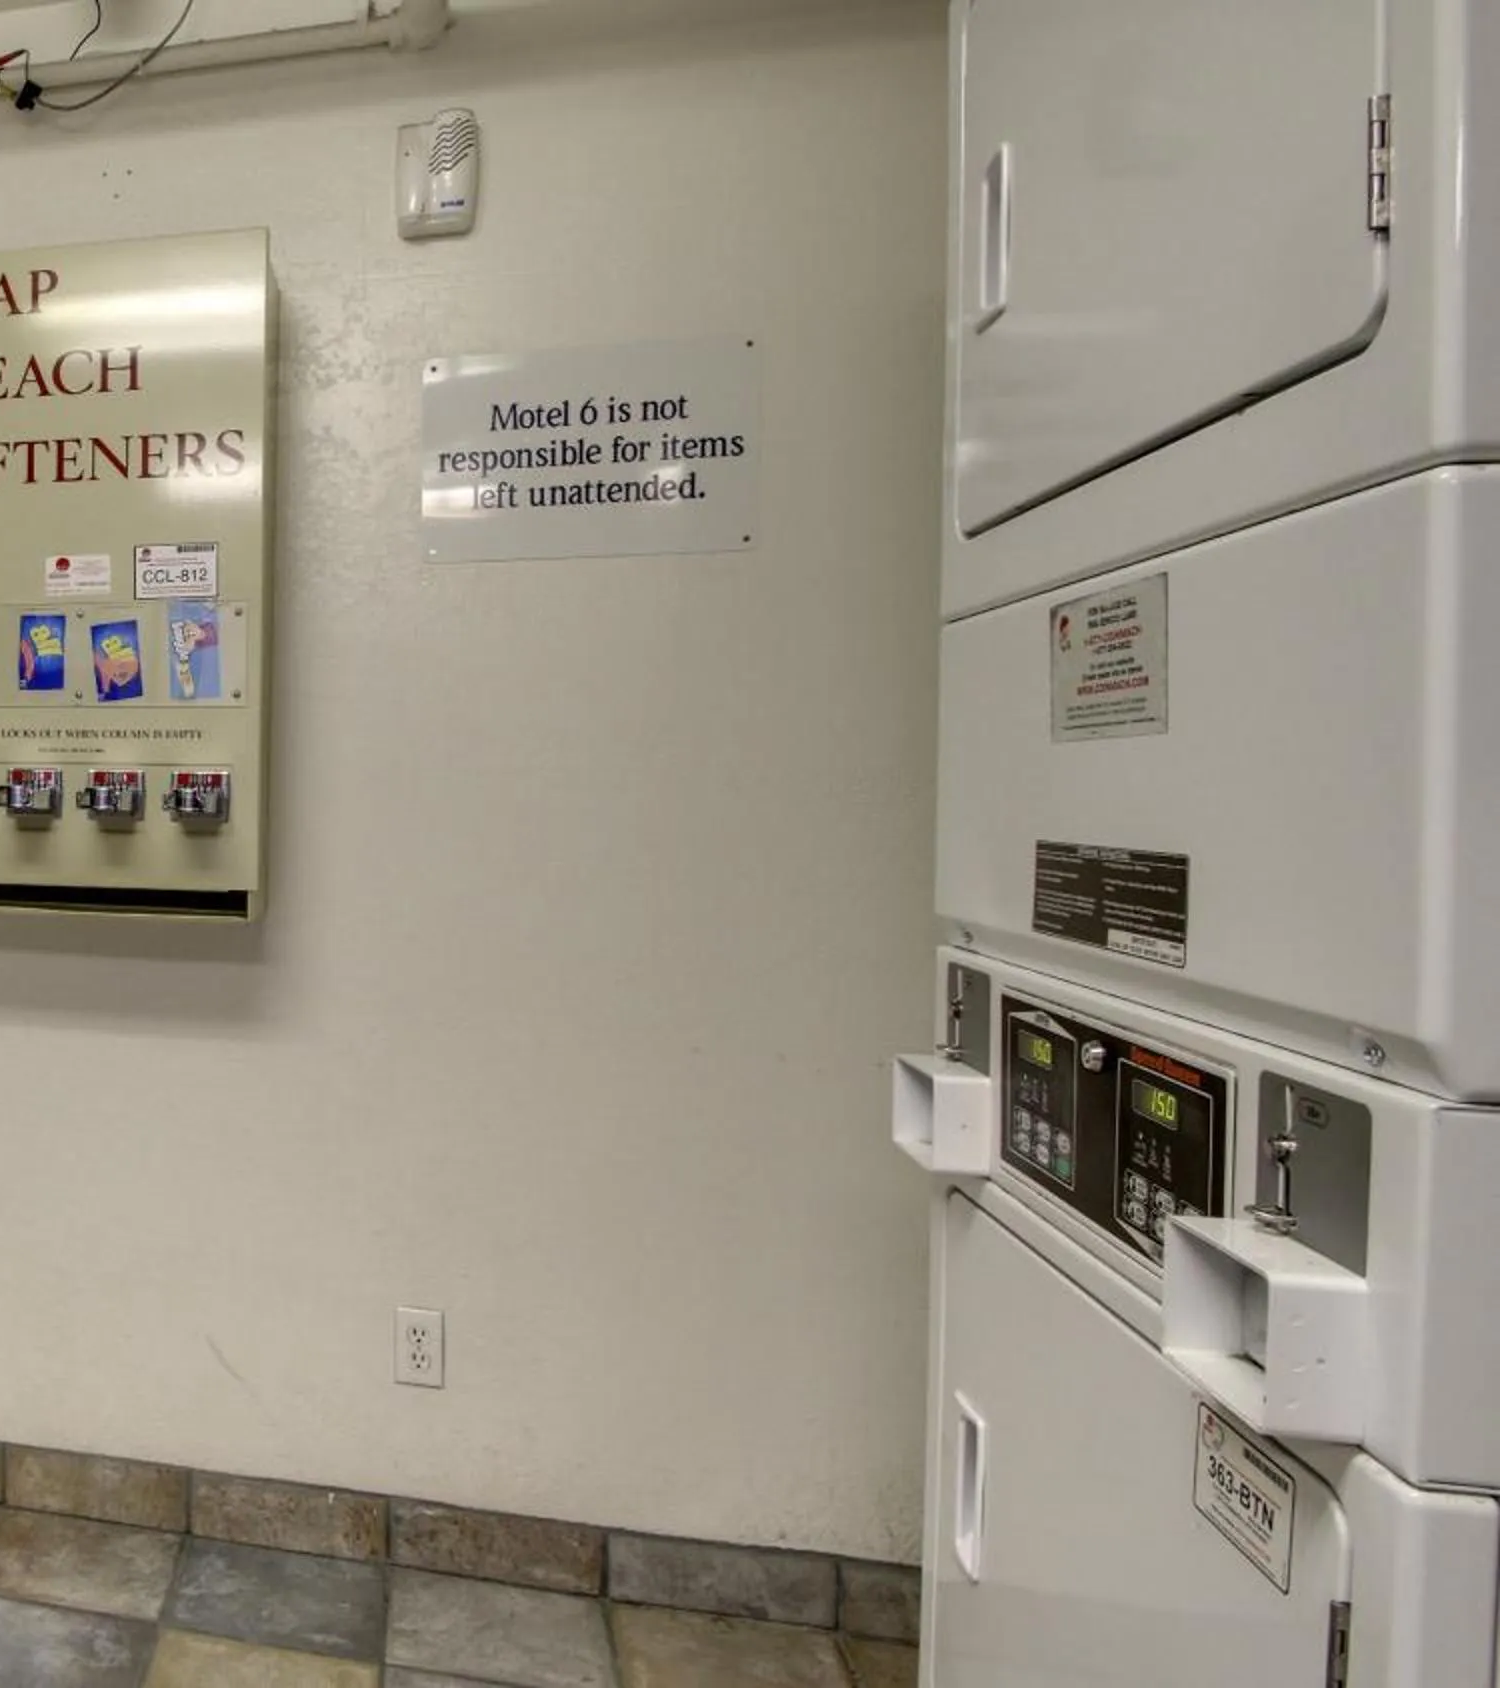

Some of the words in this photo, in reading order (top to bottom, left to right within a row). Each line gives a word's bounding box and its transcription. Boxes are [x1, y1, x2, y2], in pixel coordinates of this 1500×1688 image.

[490, 400, 570, 432] Motel
[579, 399, 598, 426] 6
[608, 396, 631, 424] is
[641, 394, 689, 422] not
[438, 438, 602, 478] responsible
[611, 435, 651, 464] for
[660, 432, 745, 462] items
[473, 480, 519, 511] left
[529, 471, 706, 508] unattended.
[142, 567, 209, 585] CCL-812
[1207, 1455, 1275, 1532] 363-BTN
